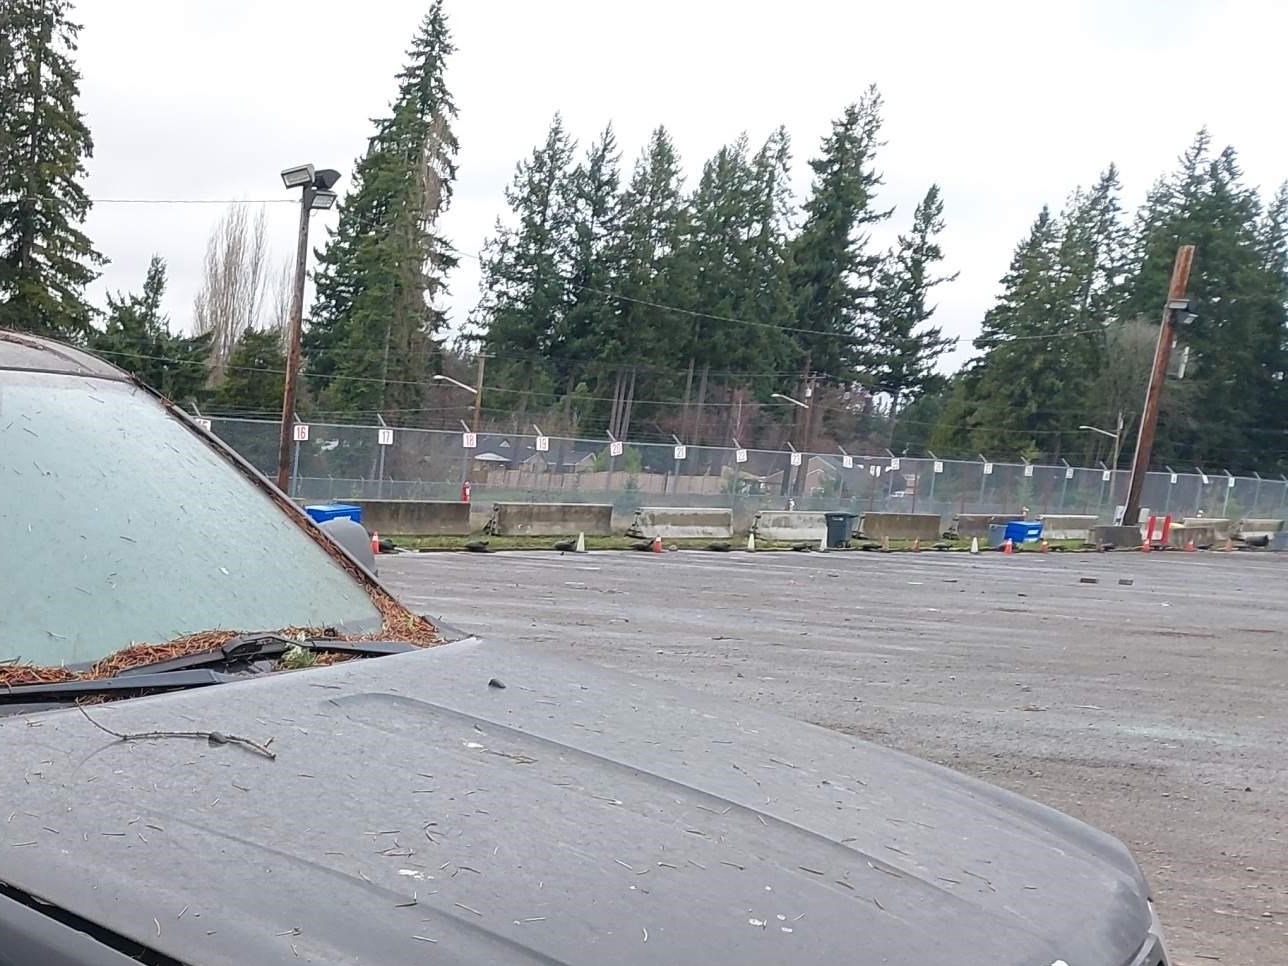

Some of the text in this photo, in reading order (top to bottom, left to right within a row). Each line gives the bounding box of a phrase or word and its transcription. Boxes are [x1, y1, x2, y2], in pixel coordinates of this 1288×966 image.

[296, 427, 307, 439] 16
[382, 431, 391, 442] 17
[465, 434, 475, 446] 18
[538, 437, 547, 449] 19
